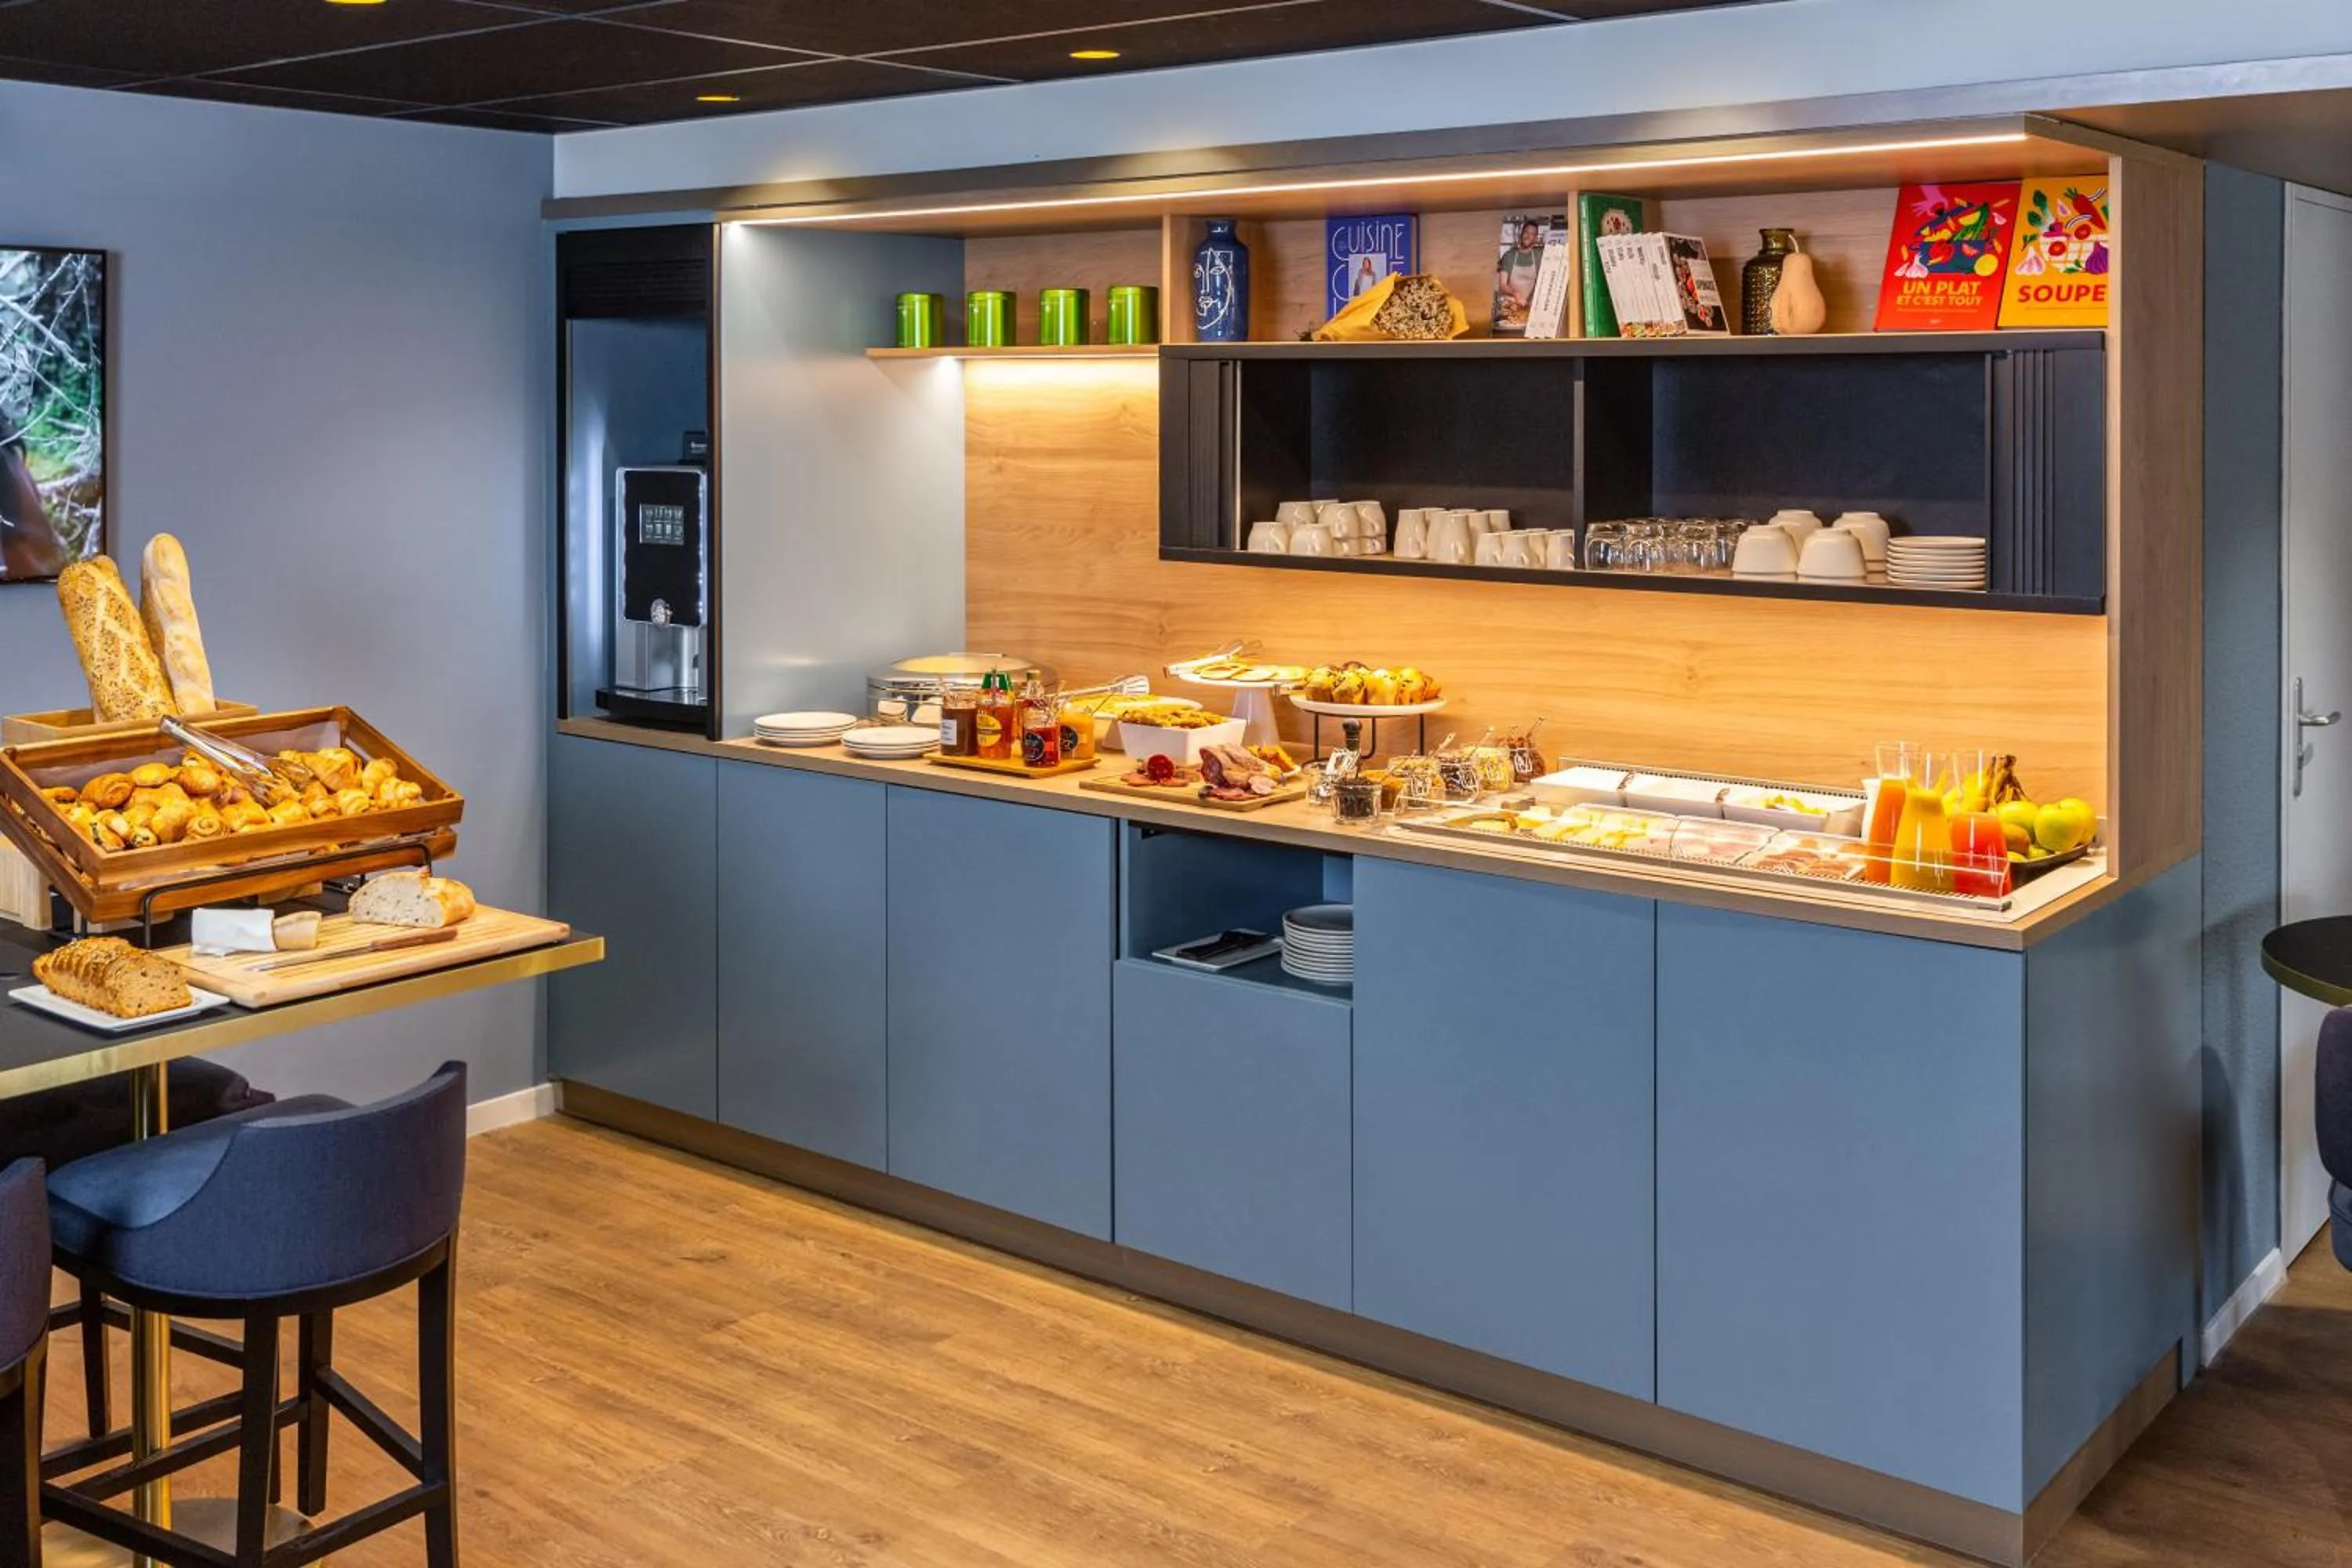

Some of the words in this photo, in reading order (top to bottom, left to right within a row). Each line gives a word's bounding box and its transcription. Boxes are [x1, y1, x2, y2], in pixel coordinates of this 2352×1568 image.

[1903, 280, 1932, 295] UN
[1935, 280, 1982, 295] PLAT
[1896, 295, 1912, 305] ET
[1912, 296, 1946, 306] C'EST
[1947, 296, 1983, 306] TOUT
